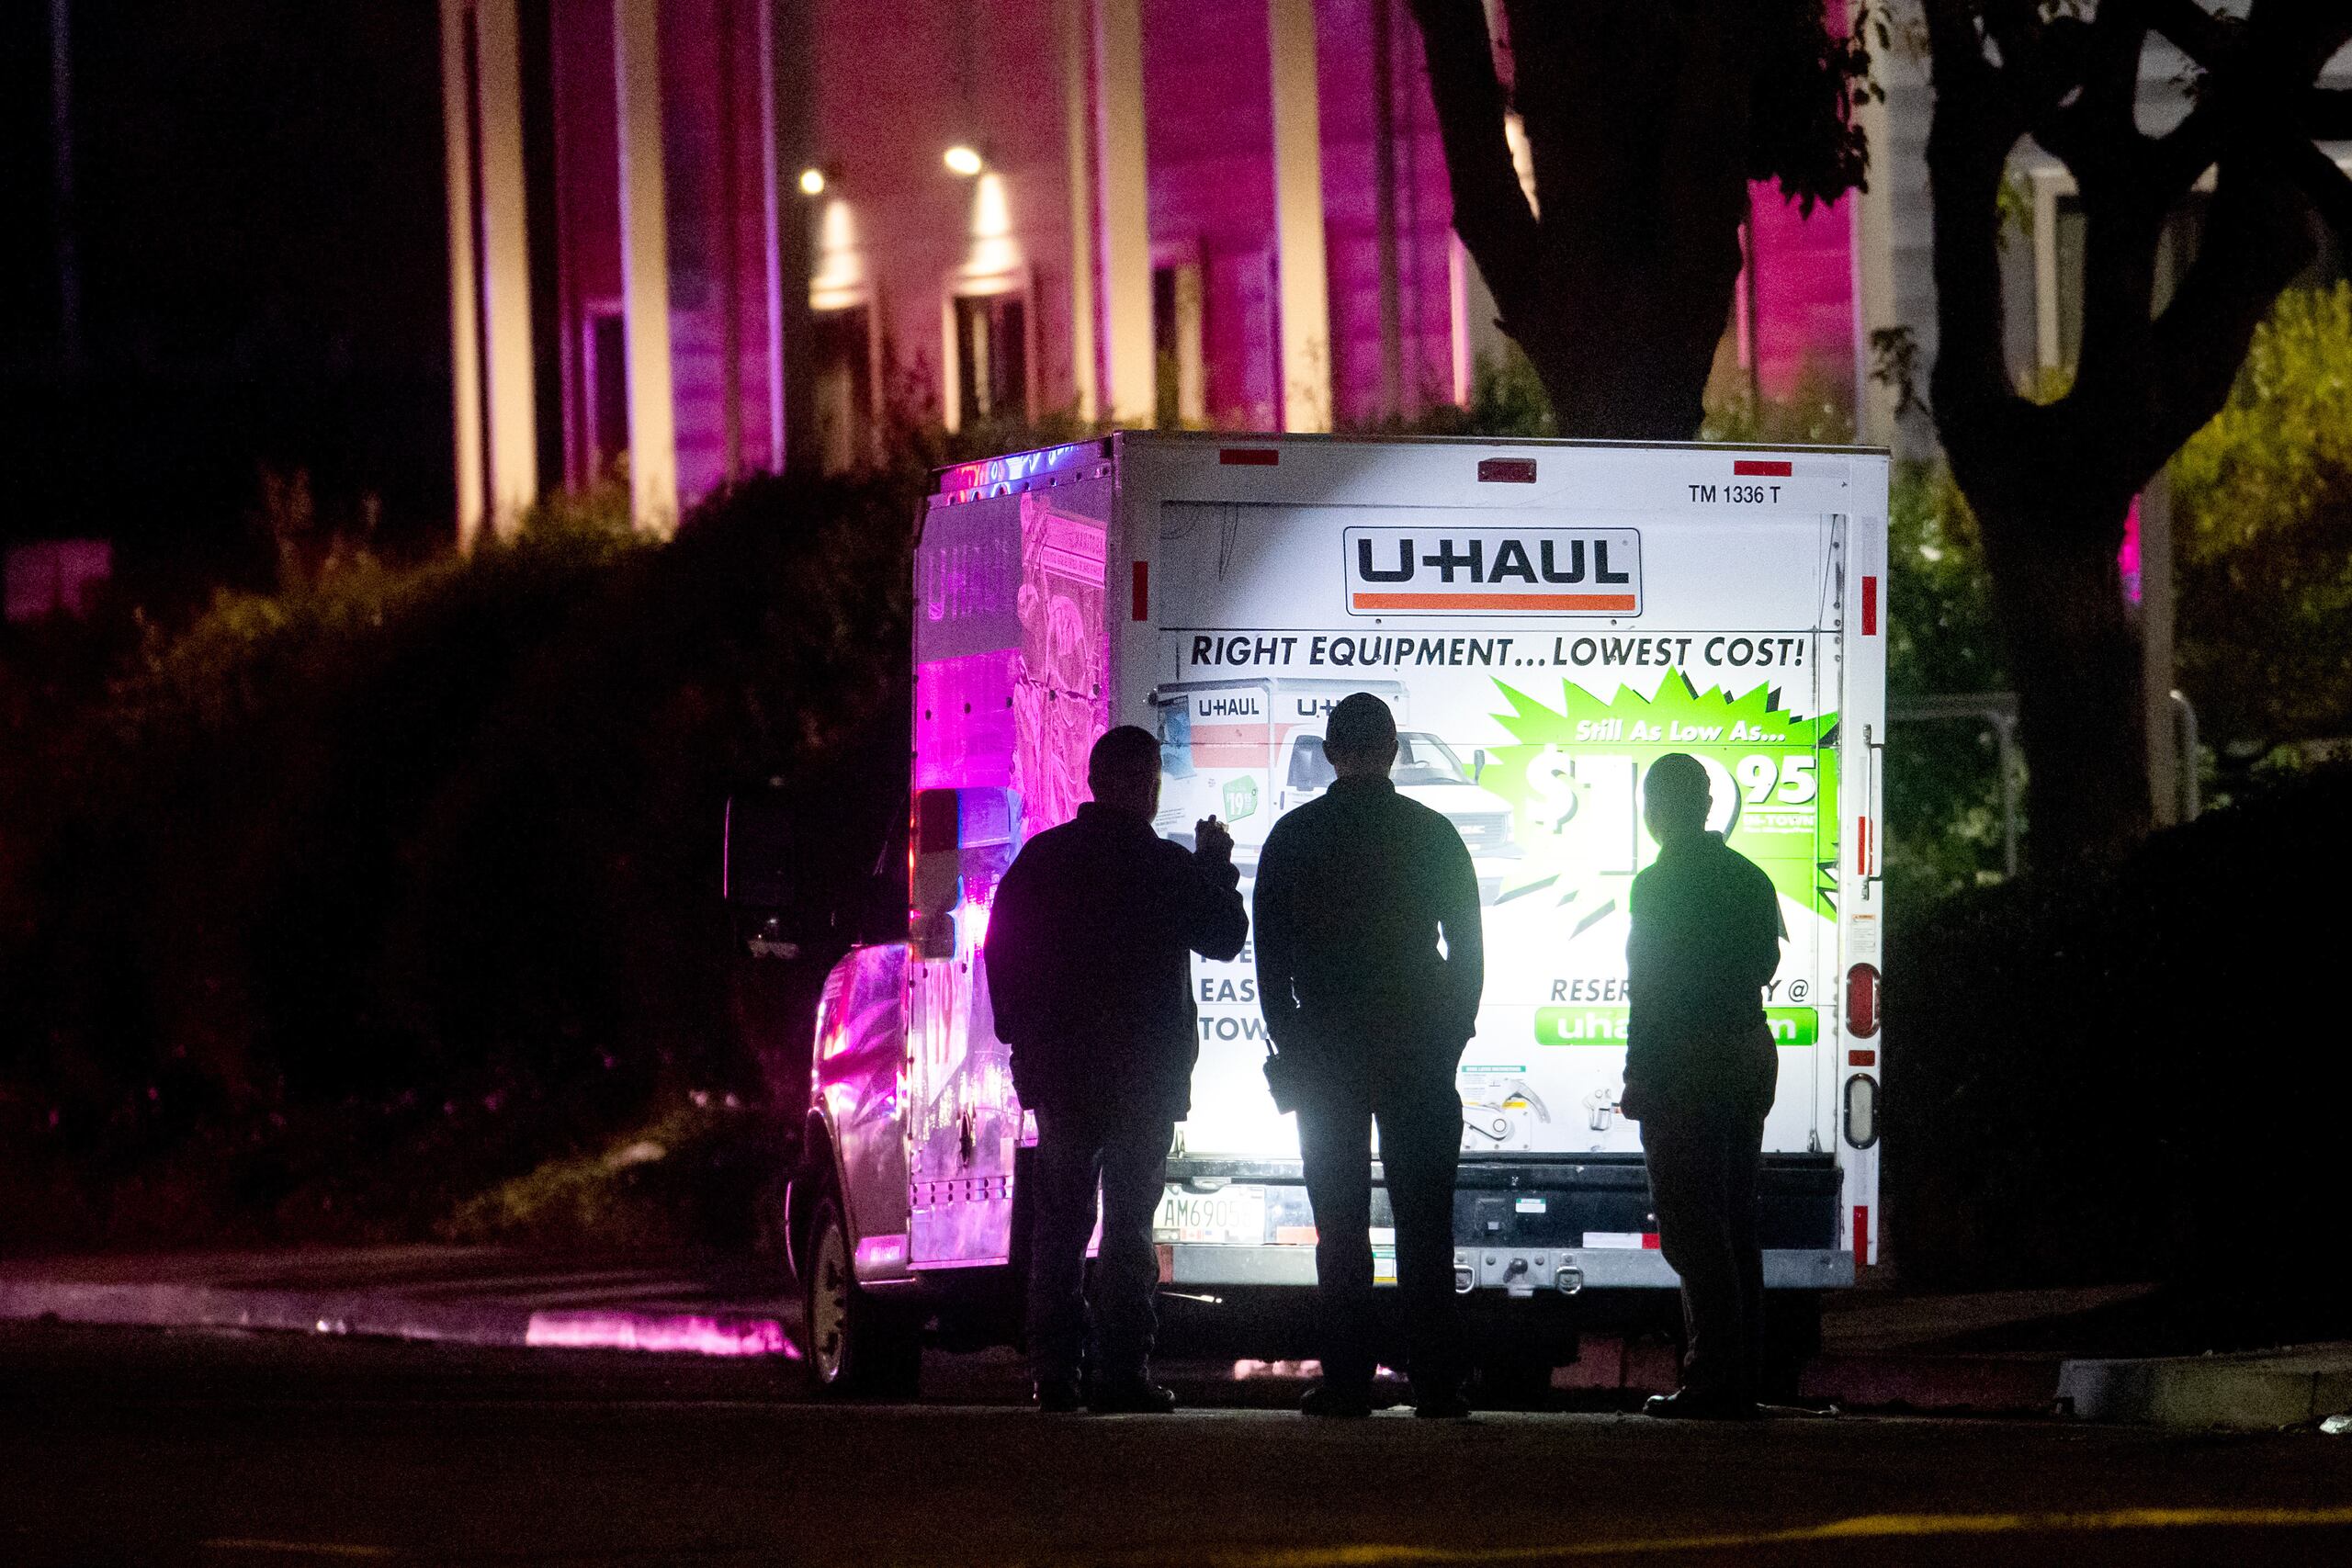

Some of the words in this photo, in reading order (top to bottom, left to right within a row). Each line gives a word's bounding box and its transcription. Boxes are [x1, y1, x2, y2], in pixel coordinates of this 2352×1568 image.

[1689, 485, 1716, 502] TM
[1724, 486, 1764, 503] 1336
[1770, 487, 1781, 503] T
[1358, 538, 1630, 584] U-HAUL
[1191, 636, 1297, 666] RIGHT
[1704, 636, 1804, 667] COST!
[1199, 698, 1260, 716] U-HAUL
[1576, 719, 1623, 742] Still
[1630, 720, 1662, 742] As
[1669, 720, 1724, 742] Low
[1200, 978, 1256, 1002] EAS
